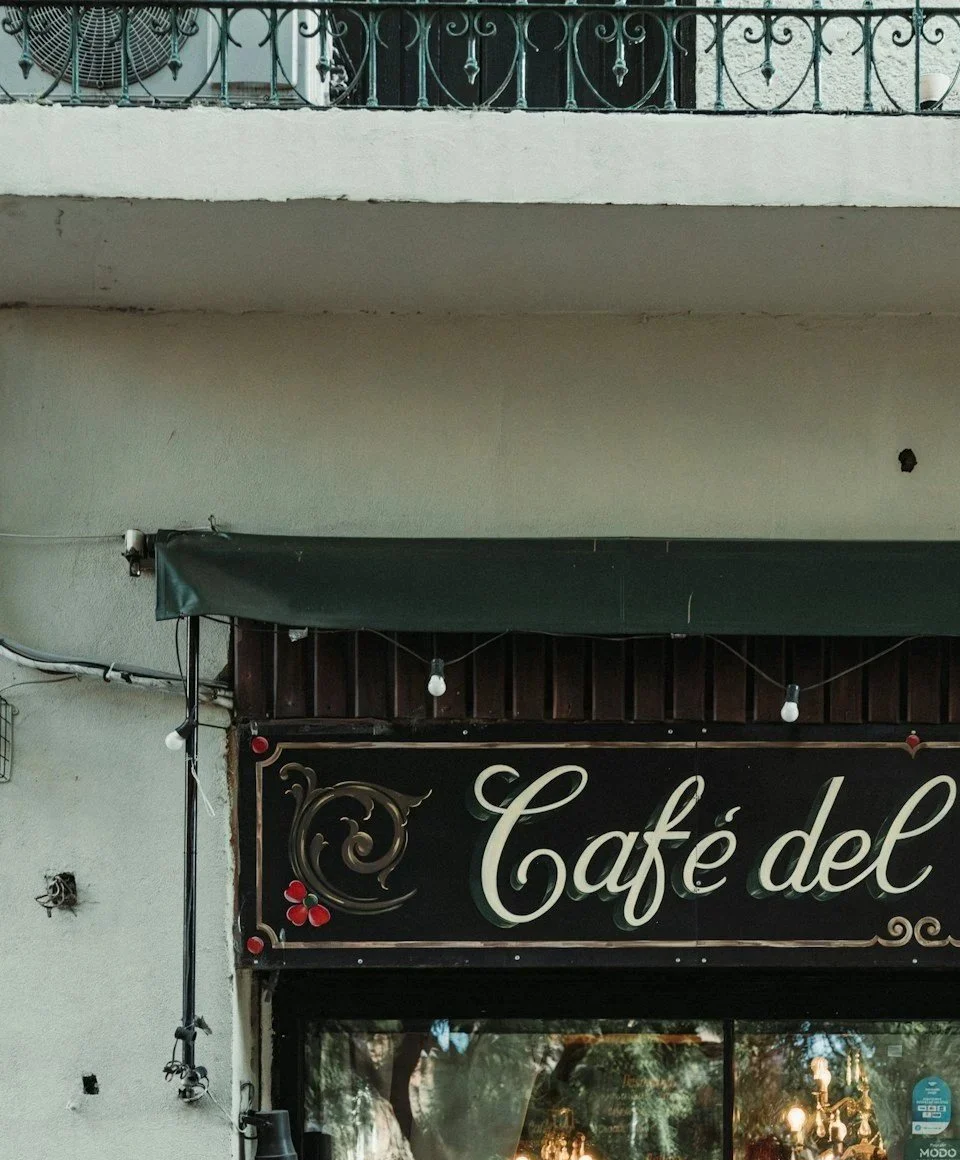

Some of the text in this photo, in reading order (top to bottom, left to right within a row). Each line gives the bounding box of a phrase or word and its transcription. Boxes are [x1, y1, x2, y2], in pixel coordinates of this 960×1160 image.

[473, 764, 737, 927] Café
[753, 773, 957, 896] del
[919, 1148, 957, 1158] MODO
